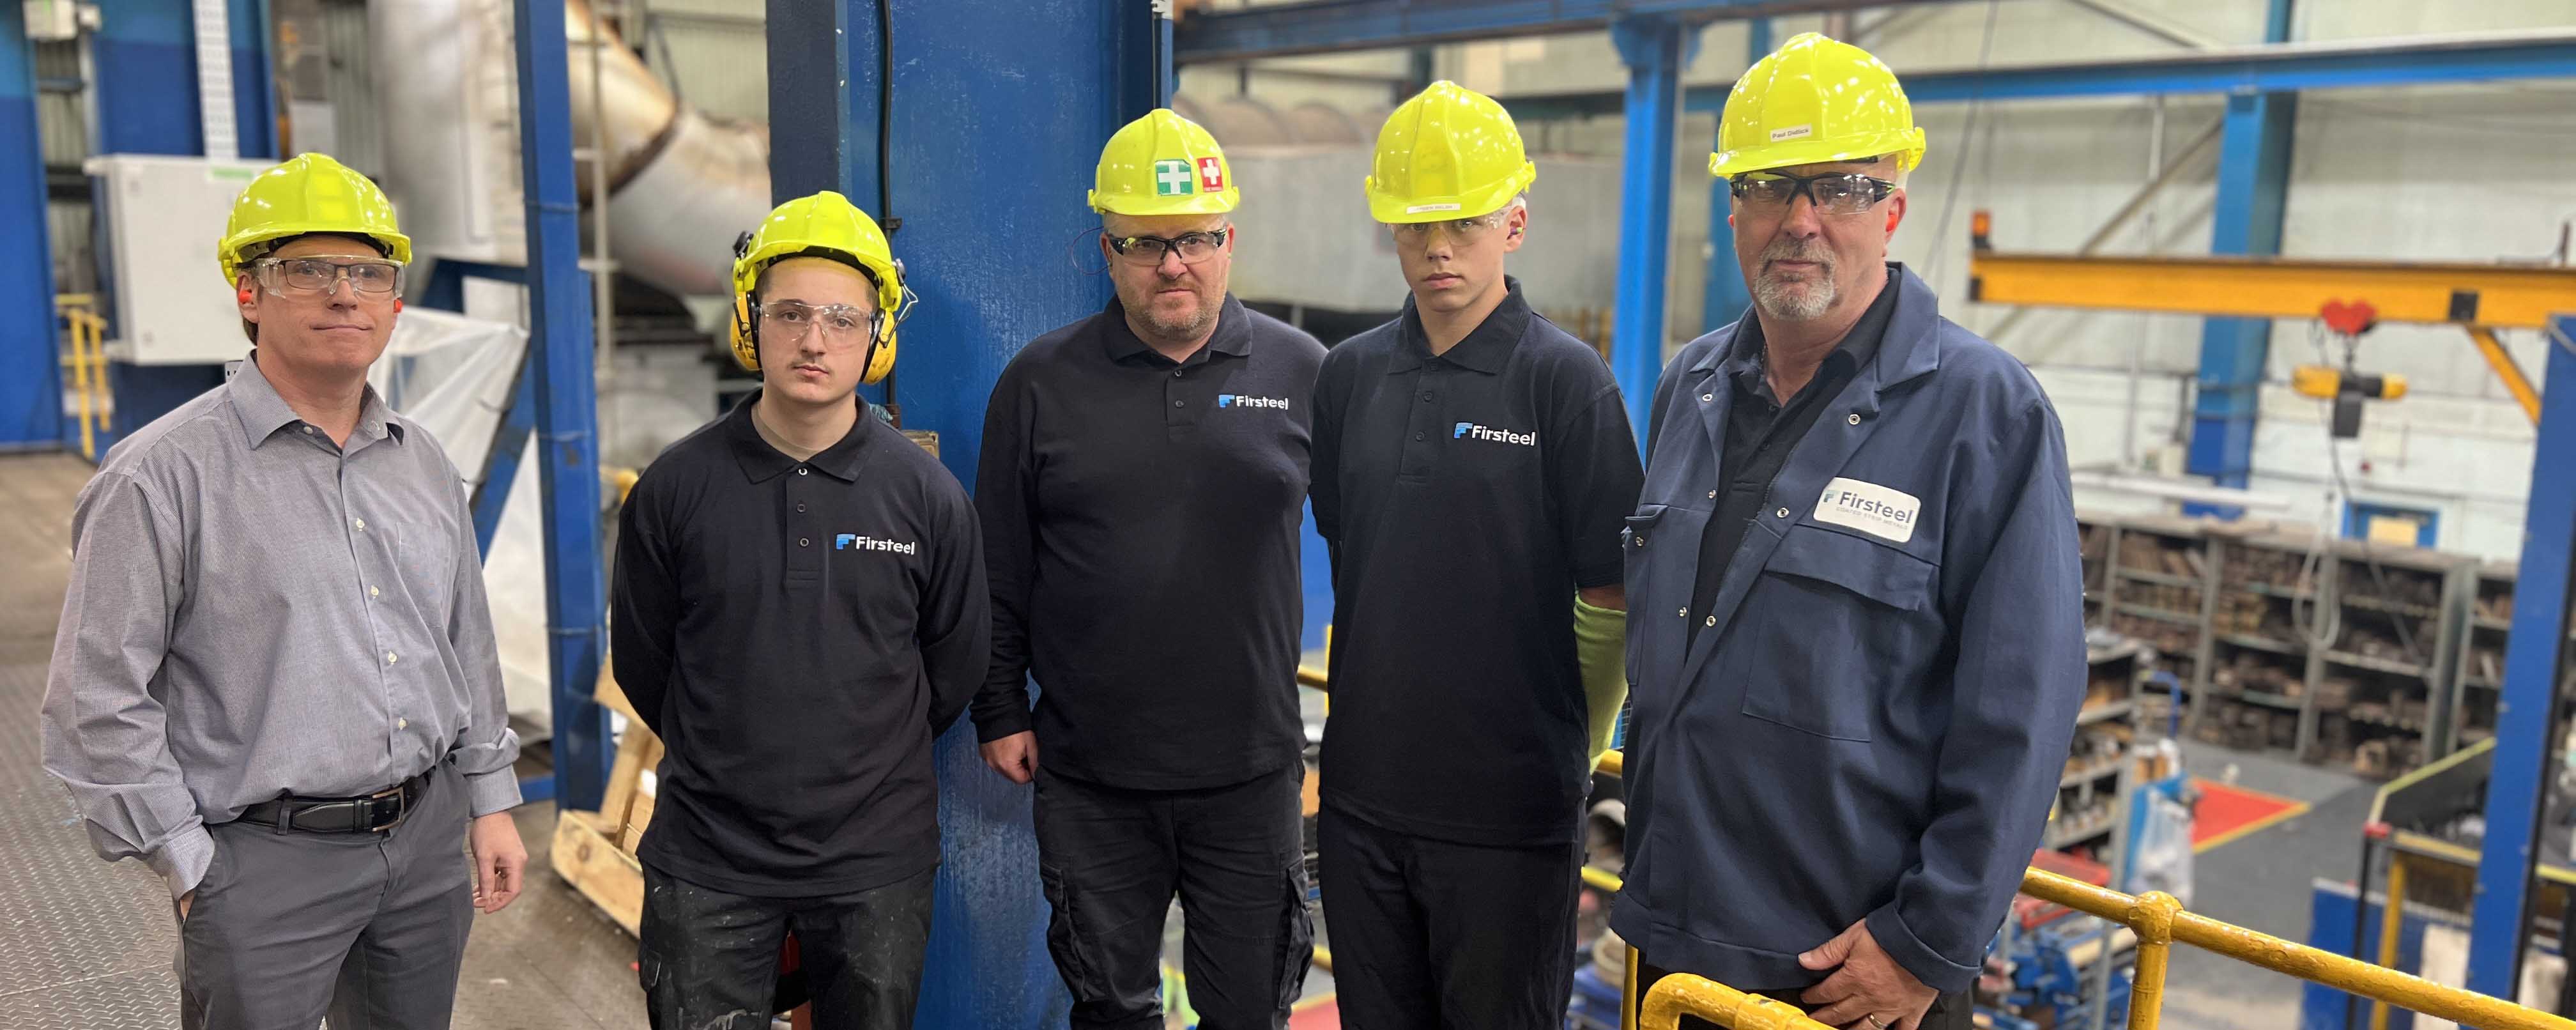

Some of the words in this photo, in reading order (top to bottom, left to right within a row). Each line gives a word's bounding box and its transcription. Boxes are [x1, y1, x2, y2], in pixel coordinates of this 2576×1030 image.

[1236, 395, 1289, 410] Firsteel
[1472, 425, 1536, 446] Firsteel
[1839, 491, 1913, 523] Firsteel
[856, 536, 916, 555] Firsteel
